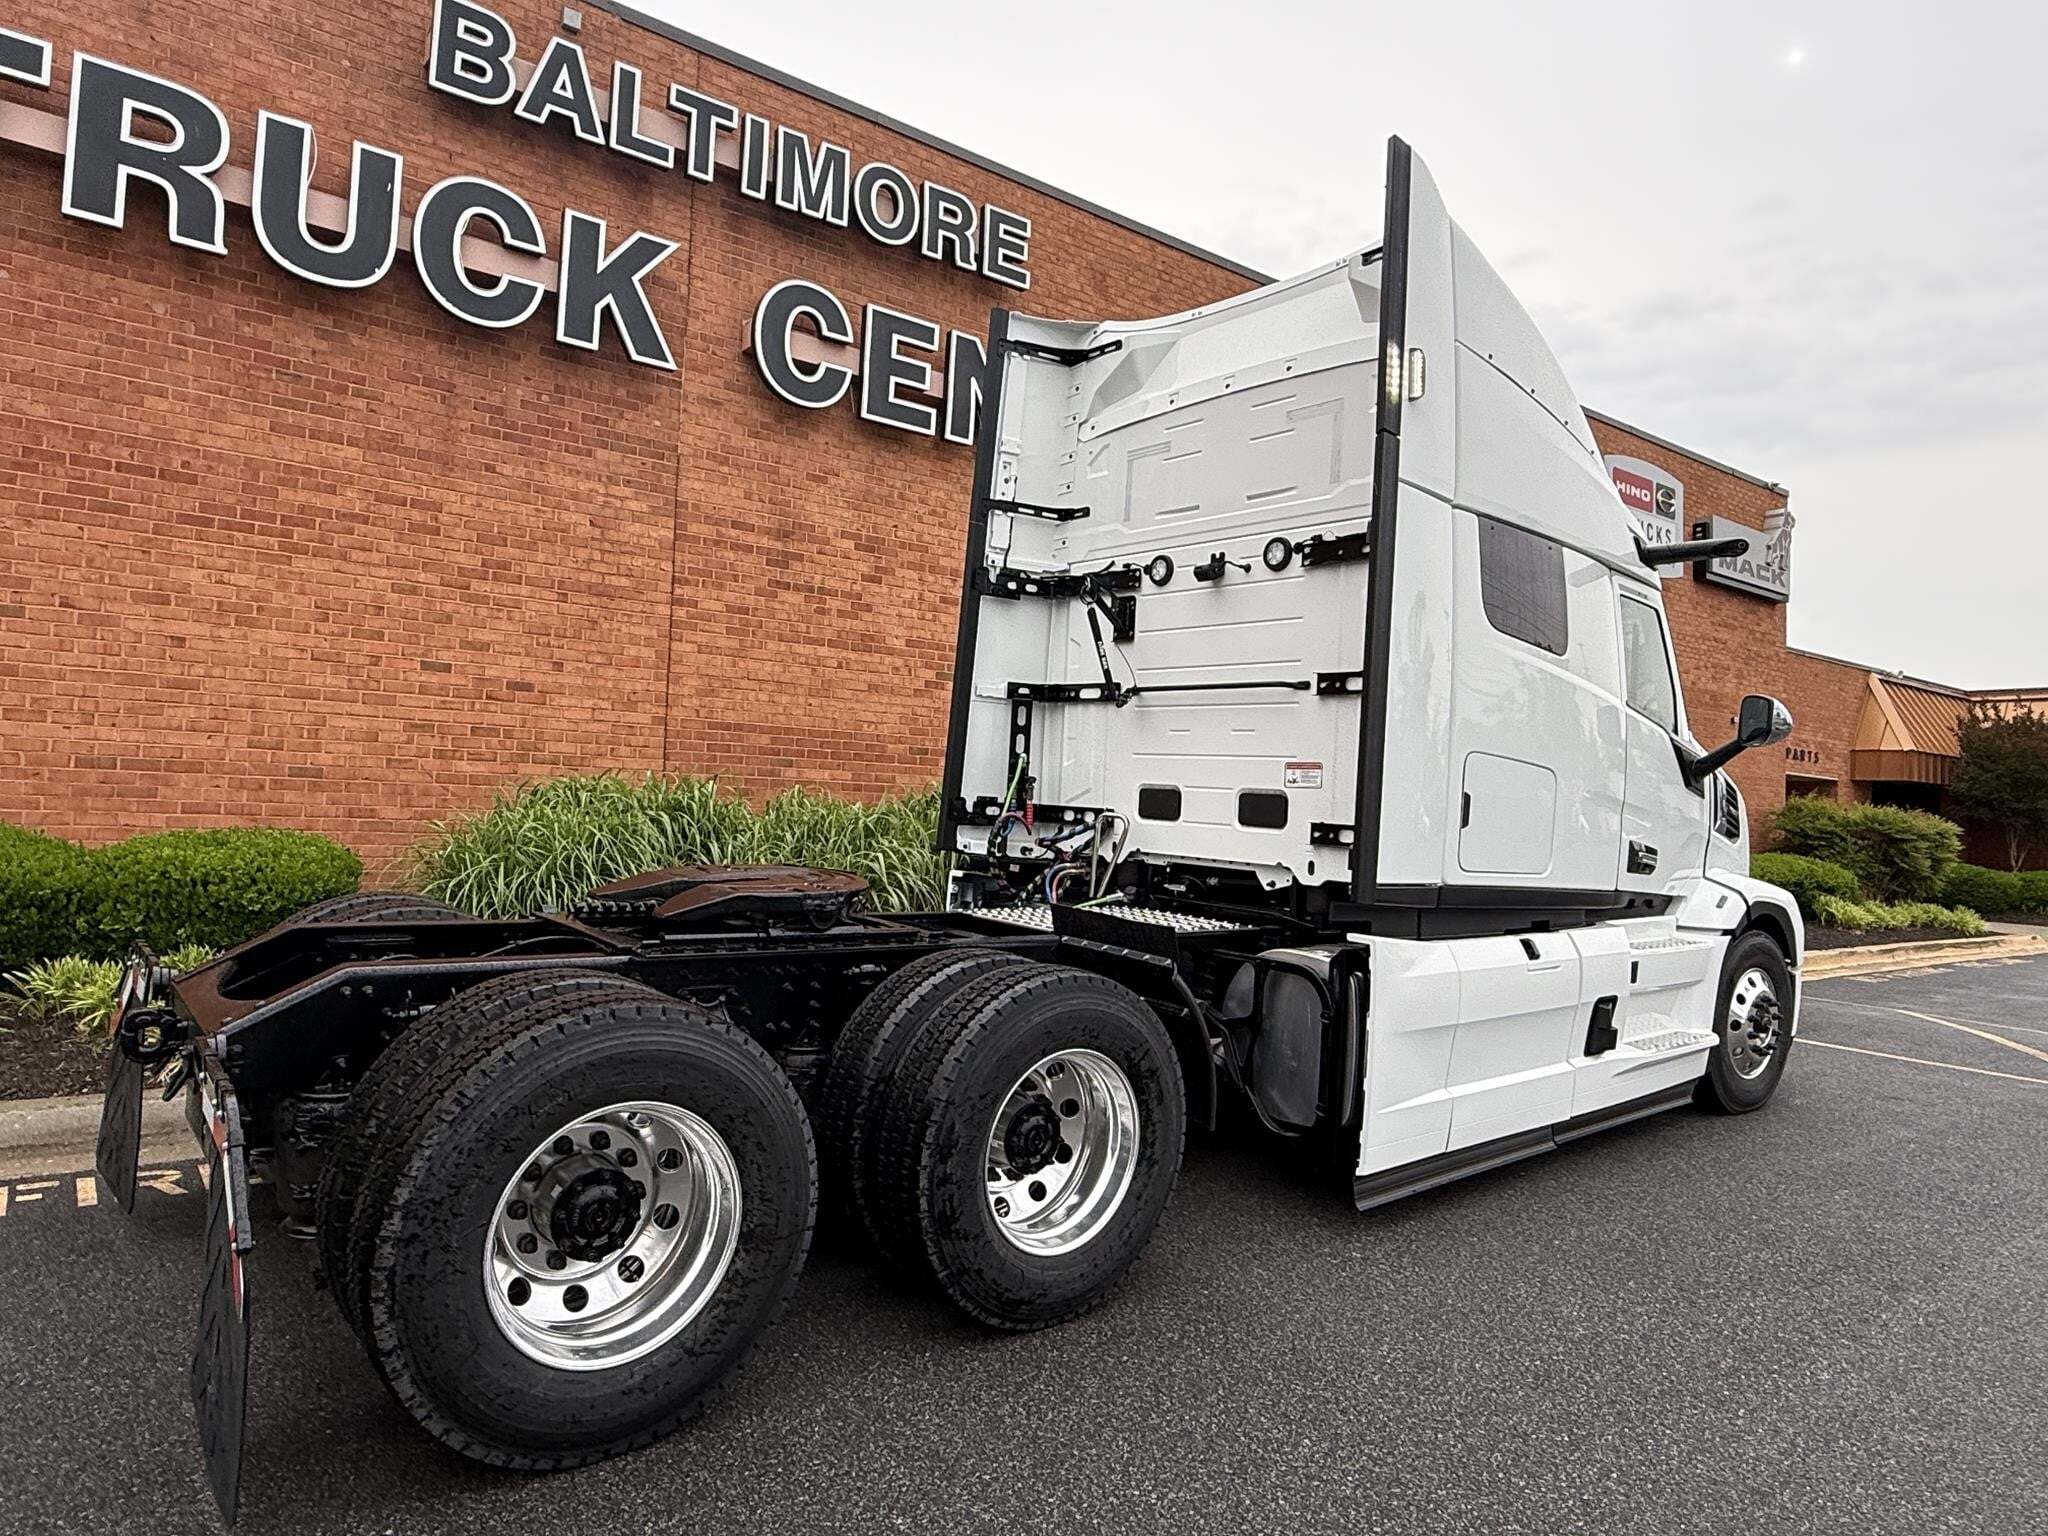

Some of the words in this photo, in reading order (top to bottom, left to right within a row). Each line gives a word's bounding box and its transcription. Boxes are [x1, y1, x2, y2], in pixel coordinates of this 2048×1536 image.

[428, 0, 1031, 291] BALTIMORE
[1616, 480, 1651, 502] HINO
[1719, 557, 1786, 588] MACK
[1785, 747, 1819, 764] PARTS
